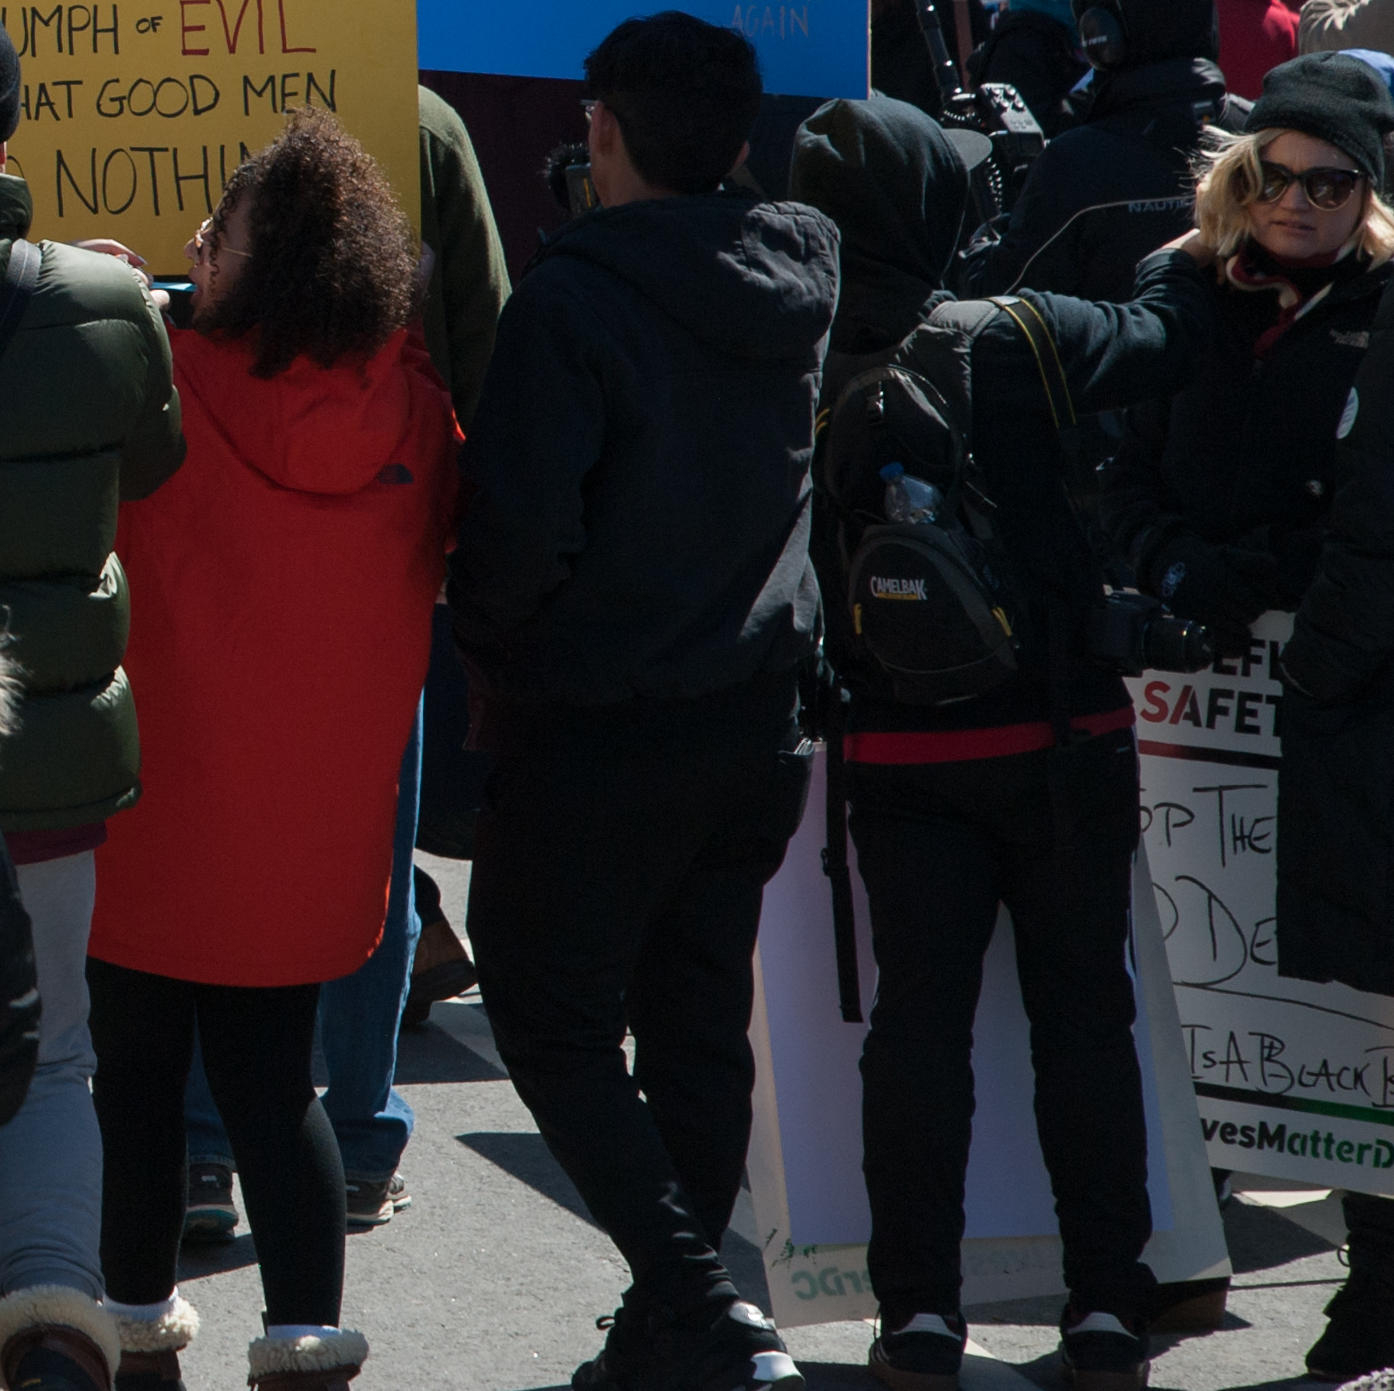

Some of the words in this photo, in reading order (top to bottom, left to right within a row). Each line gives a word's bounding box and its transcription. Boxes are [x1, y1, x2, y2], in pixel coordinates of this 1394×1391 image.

[135, 15, 164, 34] OF
[730, 5, 811, 39] AGAIN
[21, 78, 85, 121] HAT
[95, 73, 221, 119] GOOD
[242, 68, 337, 115] MEN
[55, 142, 251, 218] NOTHI
[870, 575, 928, 600] CAMELBAK
[1139, 679, 1284, 738] SAFET
[1218, 1030, 1252, 1083] A
